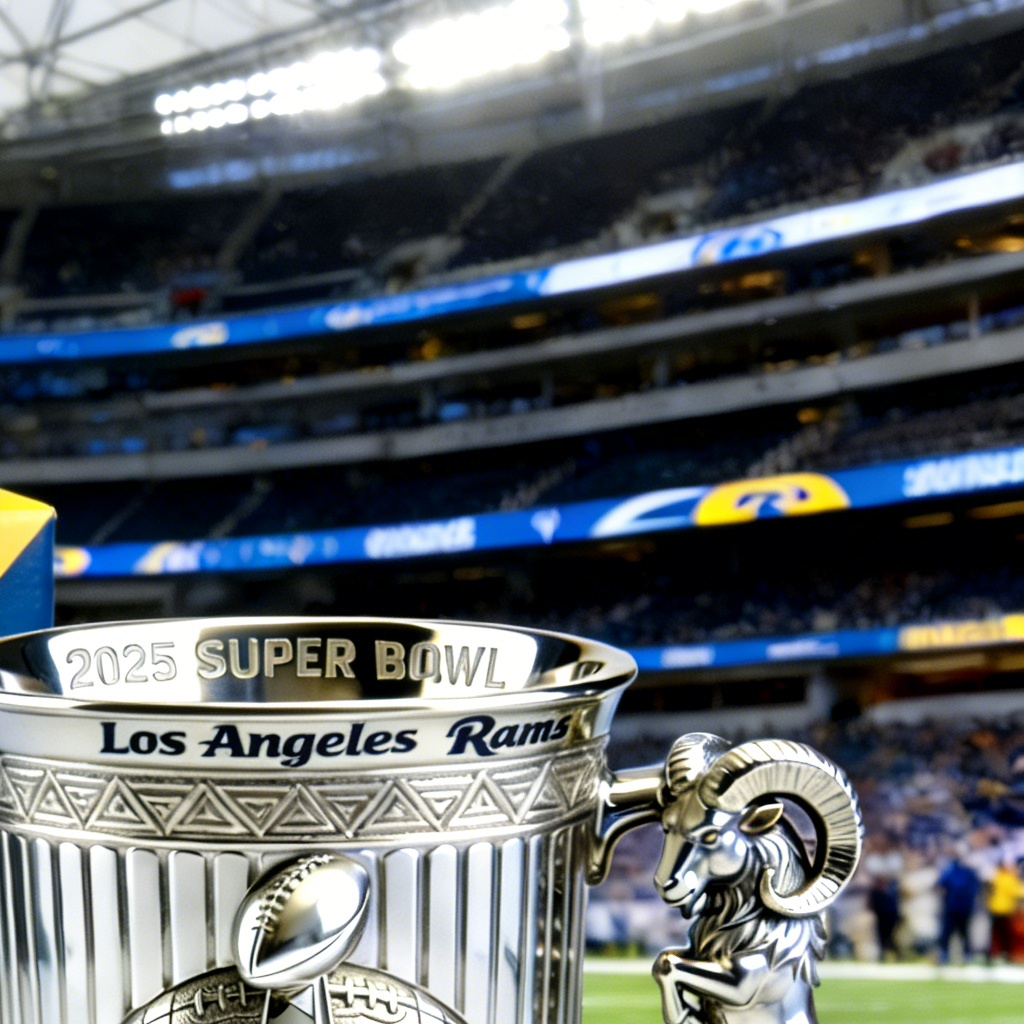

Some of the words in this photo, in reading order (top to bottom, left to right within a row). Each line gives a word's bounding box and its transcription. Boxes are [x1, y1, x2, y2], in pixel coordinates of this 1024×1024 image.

[65, 641, 177, 691] 2025
[195, 638, 356, 680] SUPER
[375, 640, 506, 689] BOWL
[100, 721, 187, 757] Los
[199, 722, 418, 768] Angeles
[445, 713, 574, 757] Rams
